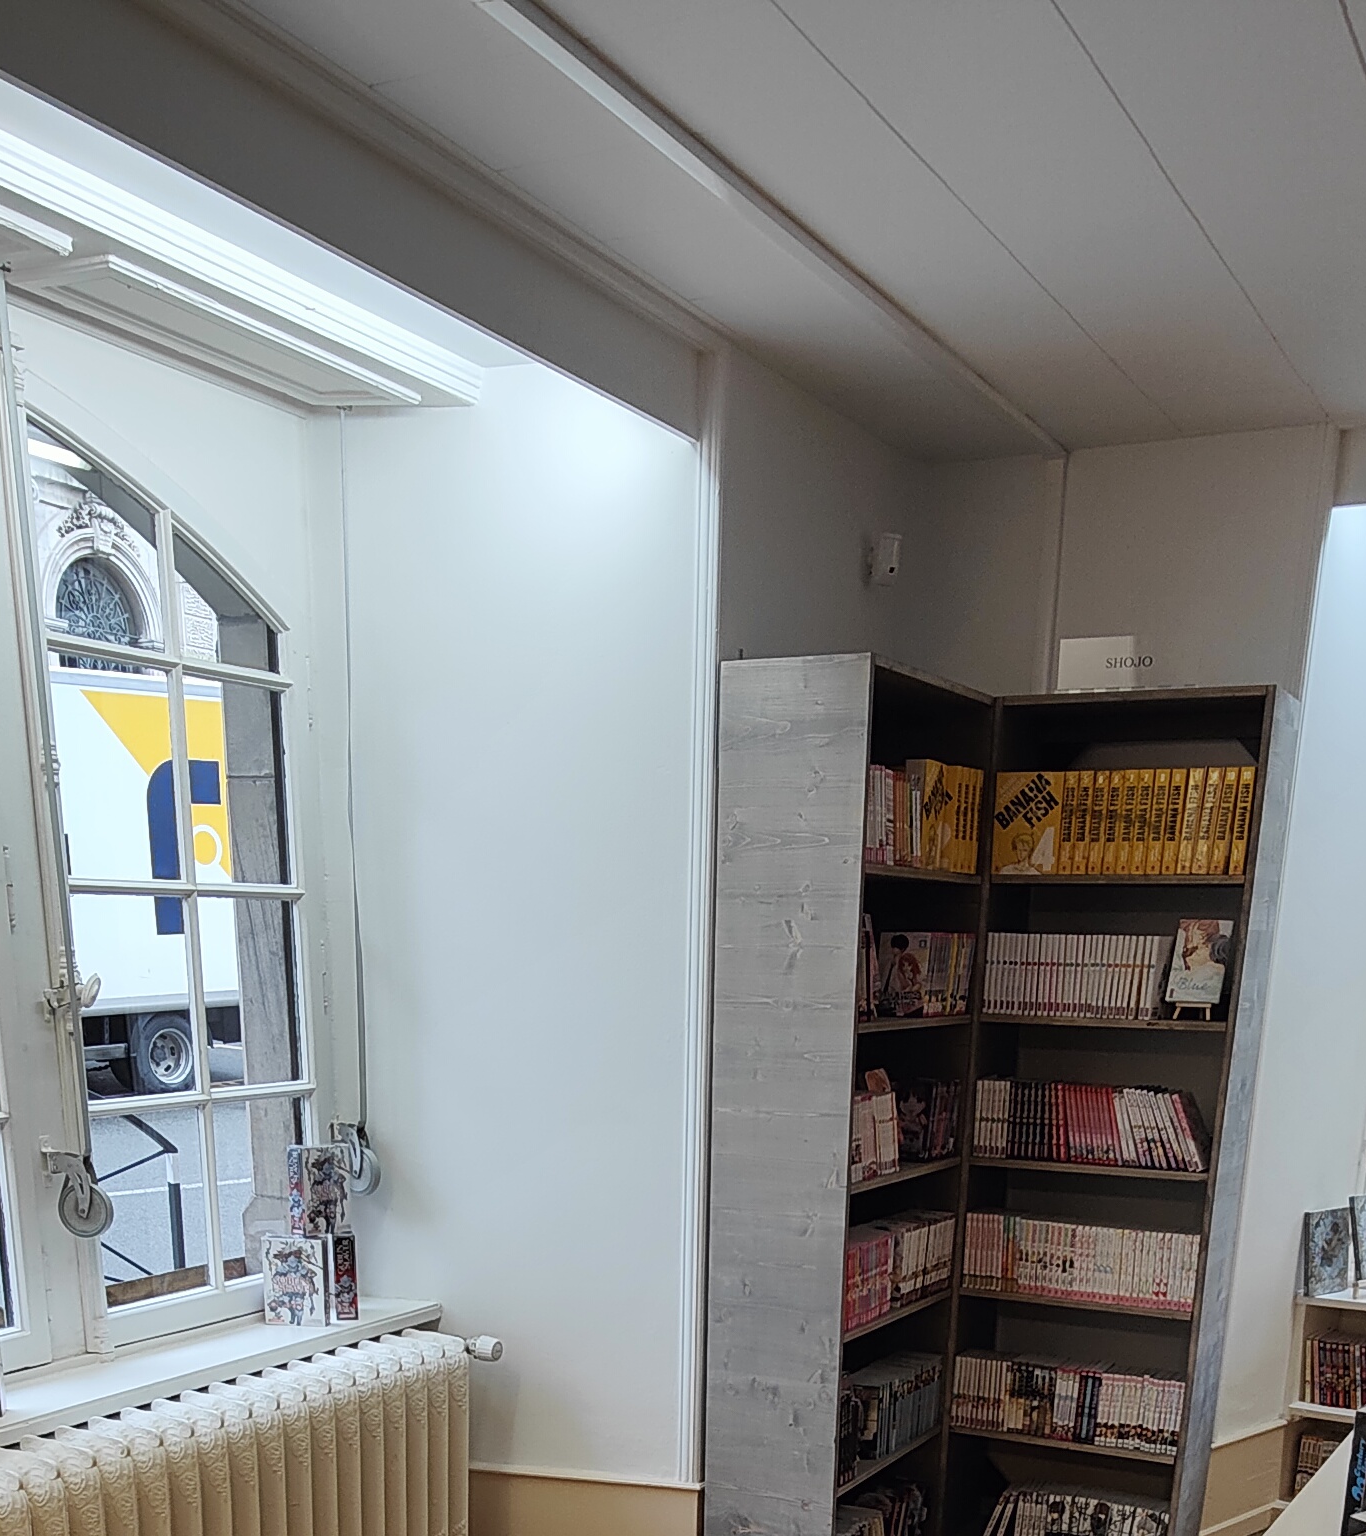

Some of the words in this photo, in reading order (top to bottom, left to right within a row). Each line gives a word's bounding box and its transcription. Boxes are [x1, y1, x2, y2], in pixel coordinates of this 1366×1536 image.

[1105, 656, 1153, 668] SHOJO
[994, 773, 1052, 830] BANANA
[1022, 791, 1059, 829] FISH
[1081, 787, 1089, 806] FISH
[1095, 787, 1105, 808] FISH
[1111, 787, 1120, 808] FISH
[1126, 786, 1136, 807] FISH
[1141, 785, 1151, 806] FISH
[1157, 785, 1167, 806] FISH
[1241, 783, 1252, 804] FISH
[1062, 807, 1074, 843] BANANA
[1068, 787, 1076, 807] FISH
[1076, 806, 1087, 842] BANANA
[1091, 809, 1101, 842] BANANA
[1106, 810, 1117, 842] BANANA
[1122, 808, 1132, 842] BANANA
[1136, 807, 1147, 842] BANANA
[1152, 807, 1163, 842] BANANA
[1167, 806, 1178, 841] BANANA
[1173, 785, 1182, 806] FISH
[1216, 805, 1229, 841] BANANA
[1224, 783, 1234, 805] FISH
[1235, 805, 1248, 841] BANANA
[1031, 827, 1055, 871] 4
